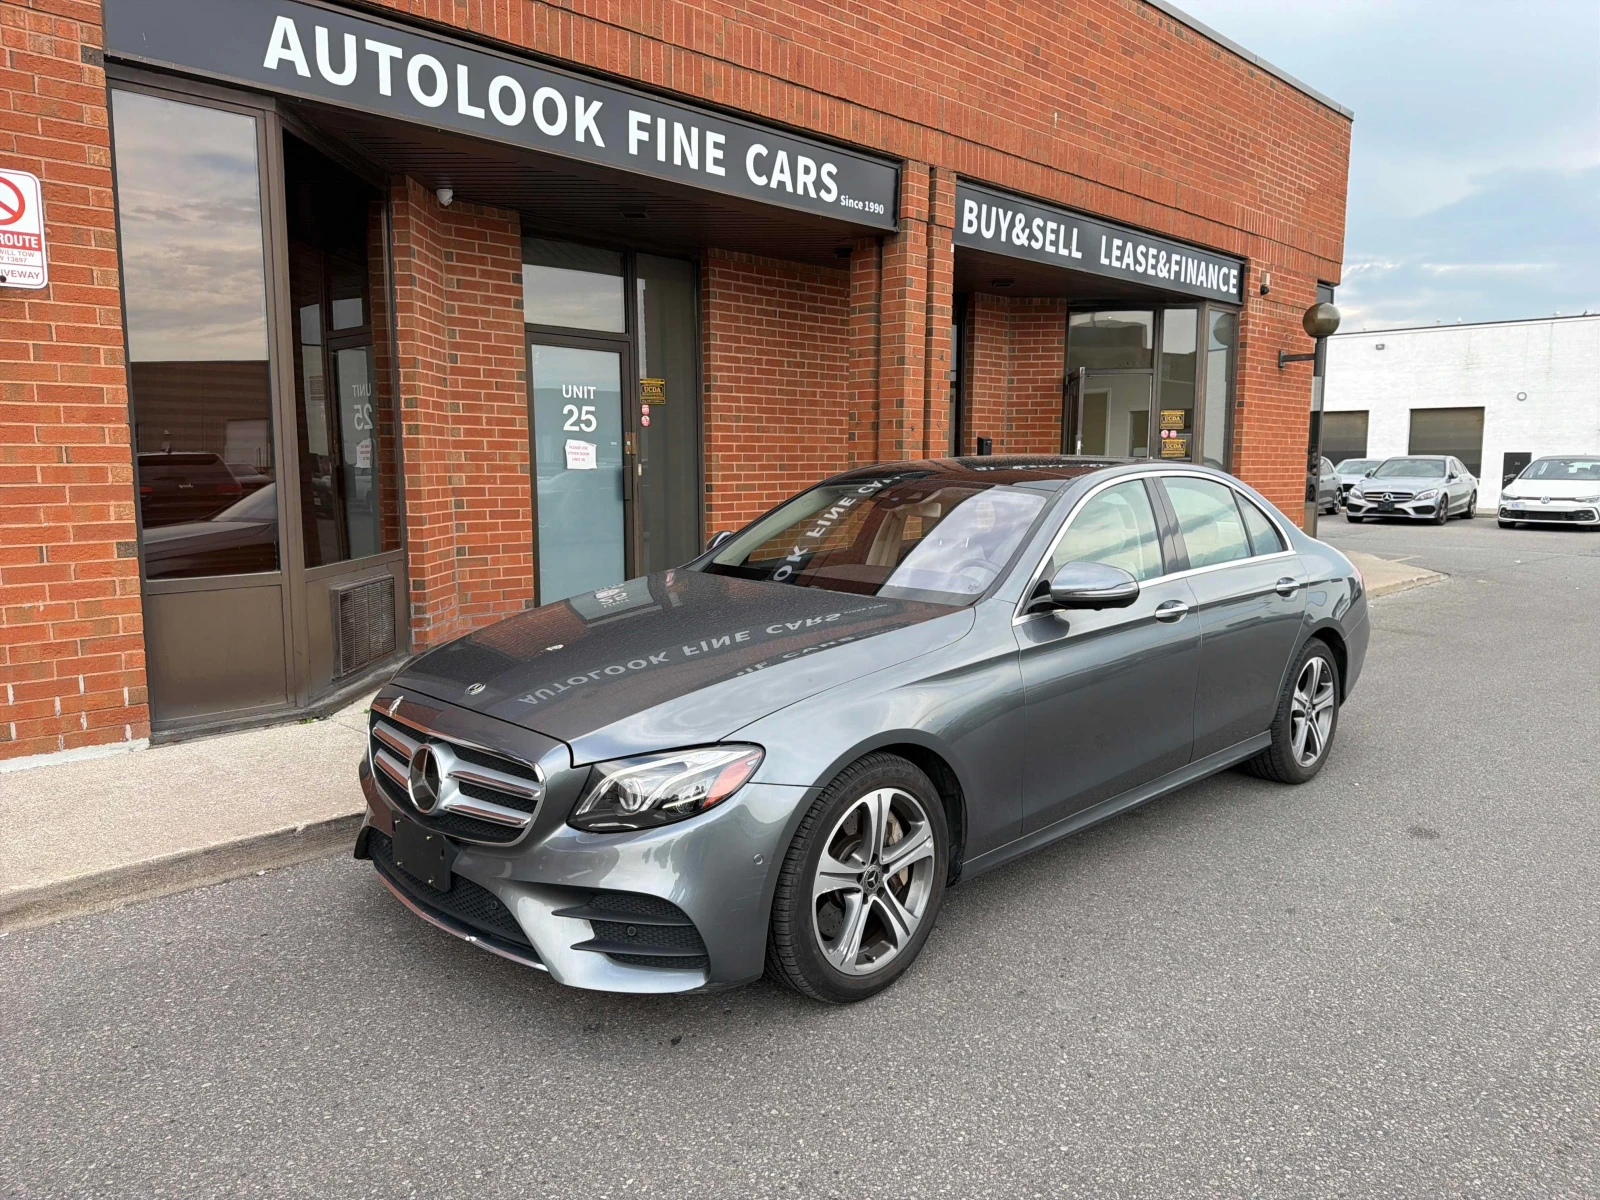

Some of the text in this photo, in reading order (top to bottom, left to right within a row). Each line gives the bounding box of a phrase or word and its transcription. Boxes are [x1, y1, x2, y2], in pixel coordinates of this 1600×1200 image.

[263, 15, 838, 203] AUTOLOOK FINE CARS
[840, 194, 885, 215] Since 1990
[962, 198, 1238, 295] BUY&SELL LEASE&FINANCE
[562, 384, 597, 399] UNIT
[562, 404, 597, 432] 25
